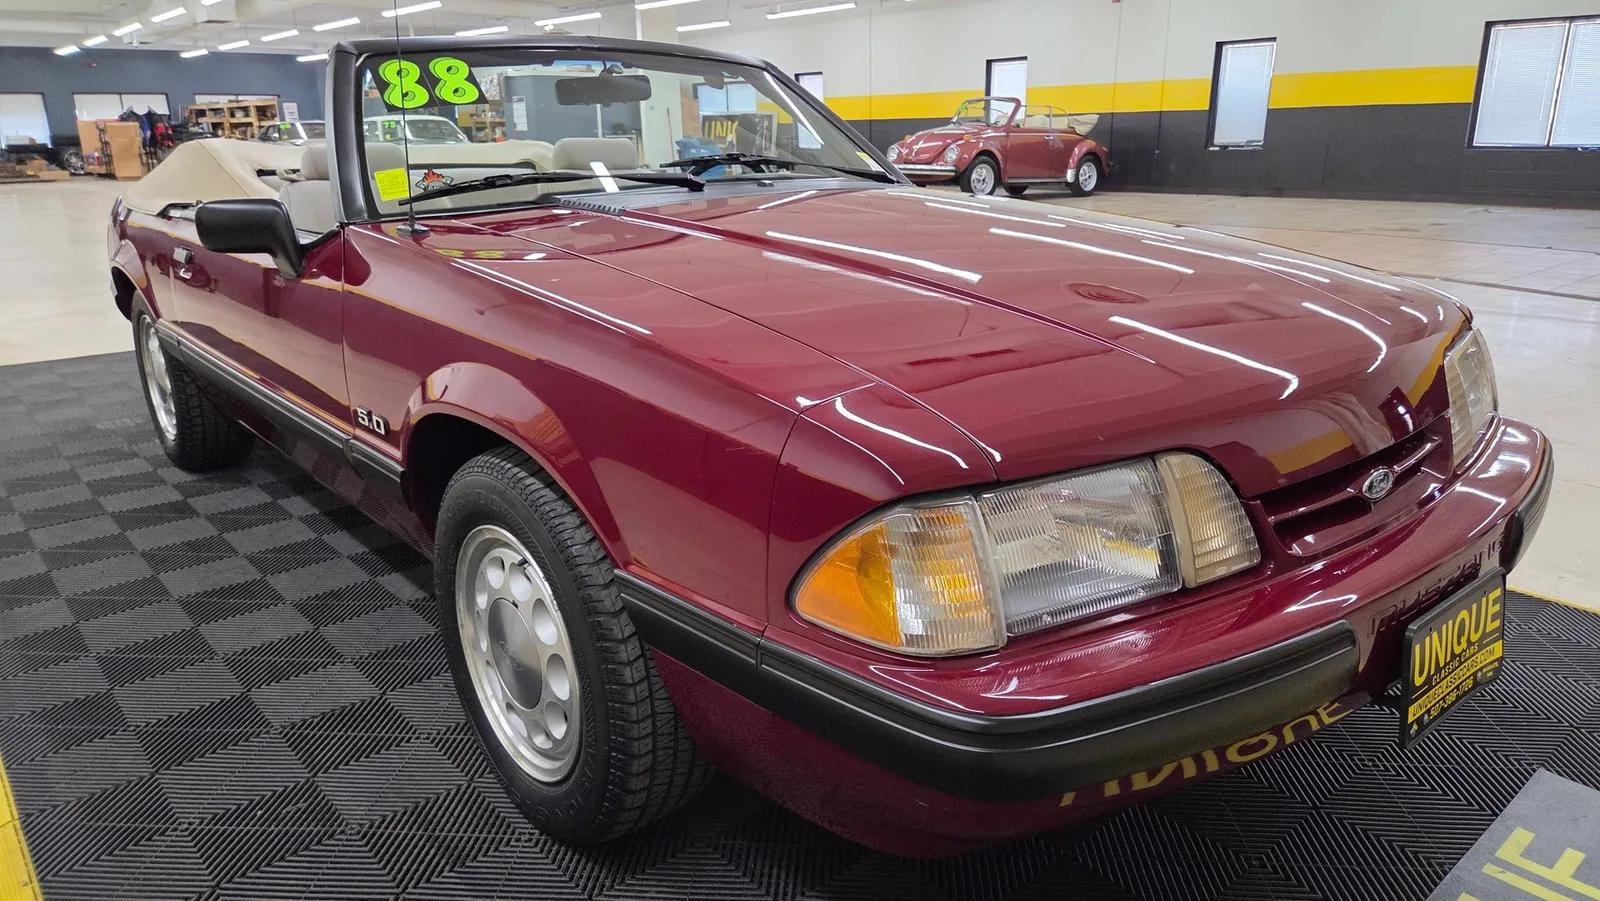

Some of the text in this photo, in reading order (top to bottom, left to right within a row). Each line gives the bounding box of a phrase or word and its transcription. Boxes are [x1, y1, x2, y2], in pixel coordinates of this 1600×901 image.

[378, 57, 480, 109] 88
[356, 406, 387, 435] 5.0
[1413, 587, 1502, 687] UNIQUE
[1432, 654, 1461, 686] CLASSIC
[1461, 642, 1479, 662] CARS
